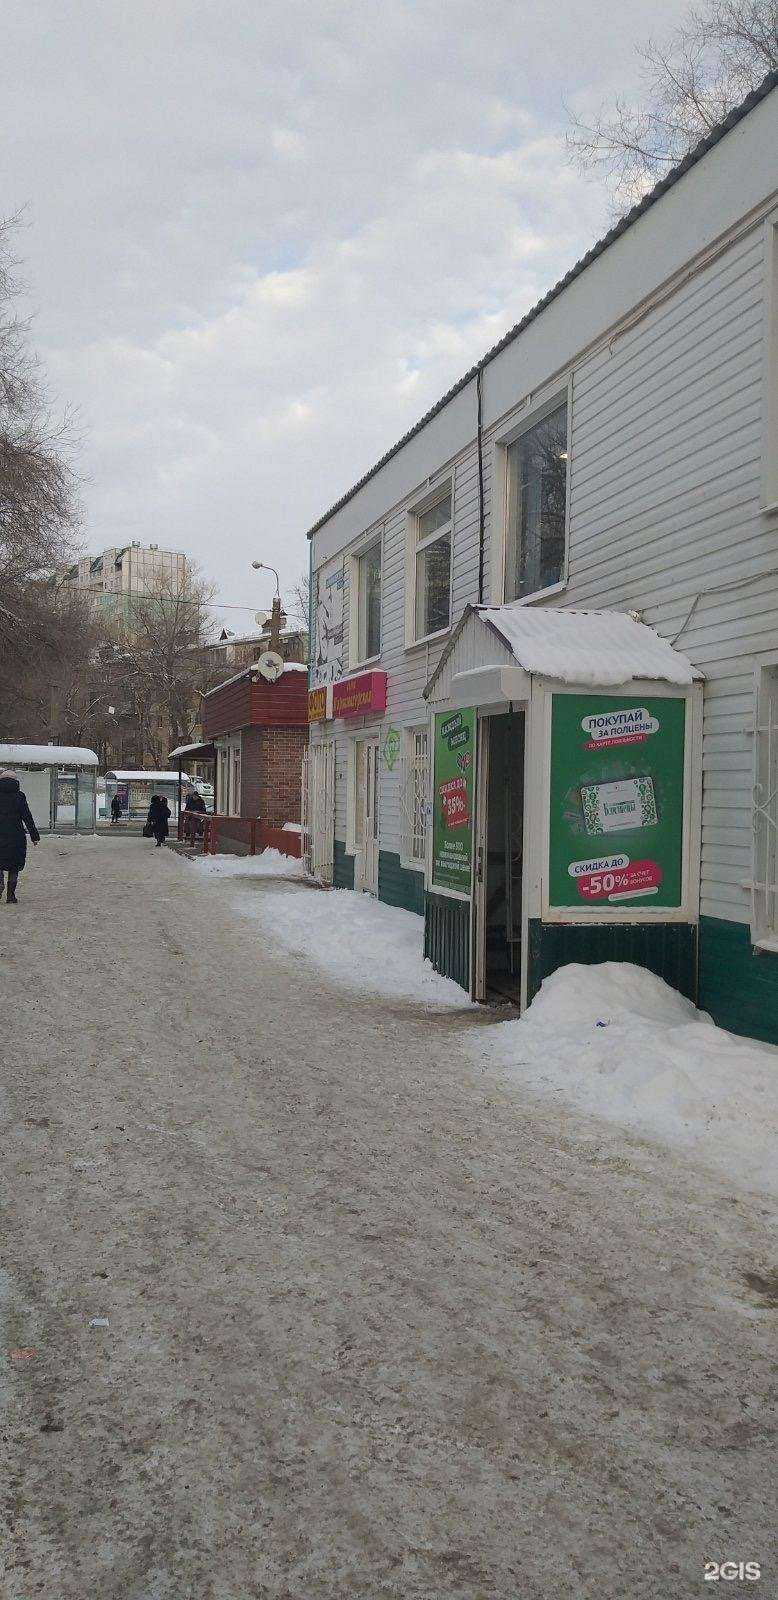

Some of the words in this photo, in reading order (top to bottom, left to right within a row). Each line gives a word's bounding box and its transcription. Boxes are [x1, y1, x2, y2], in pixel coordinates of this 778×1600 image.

[589, 710, 643, 729] ПОКУПАЙ
[598, 730, 609, 738] ЗА
[611, 722, 653, 736] ПОЛЦЕНЫ
[574, 860, 610, 874] СКИДКА
[610, 858, 624, 869] ДО
